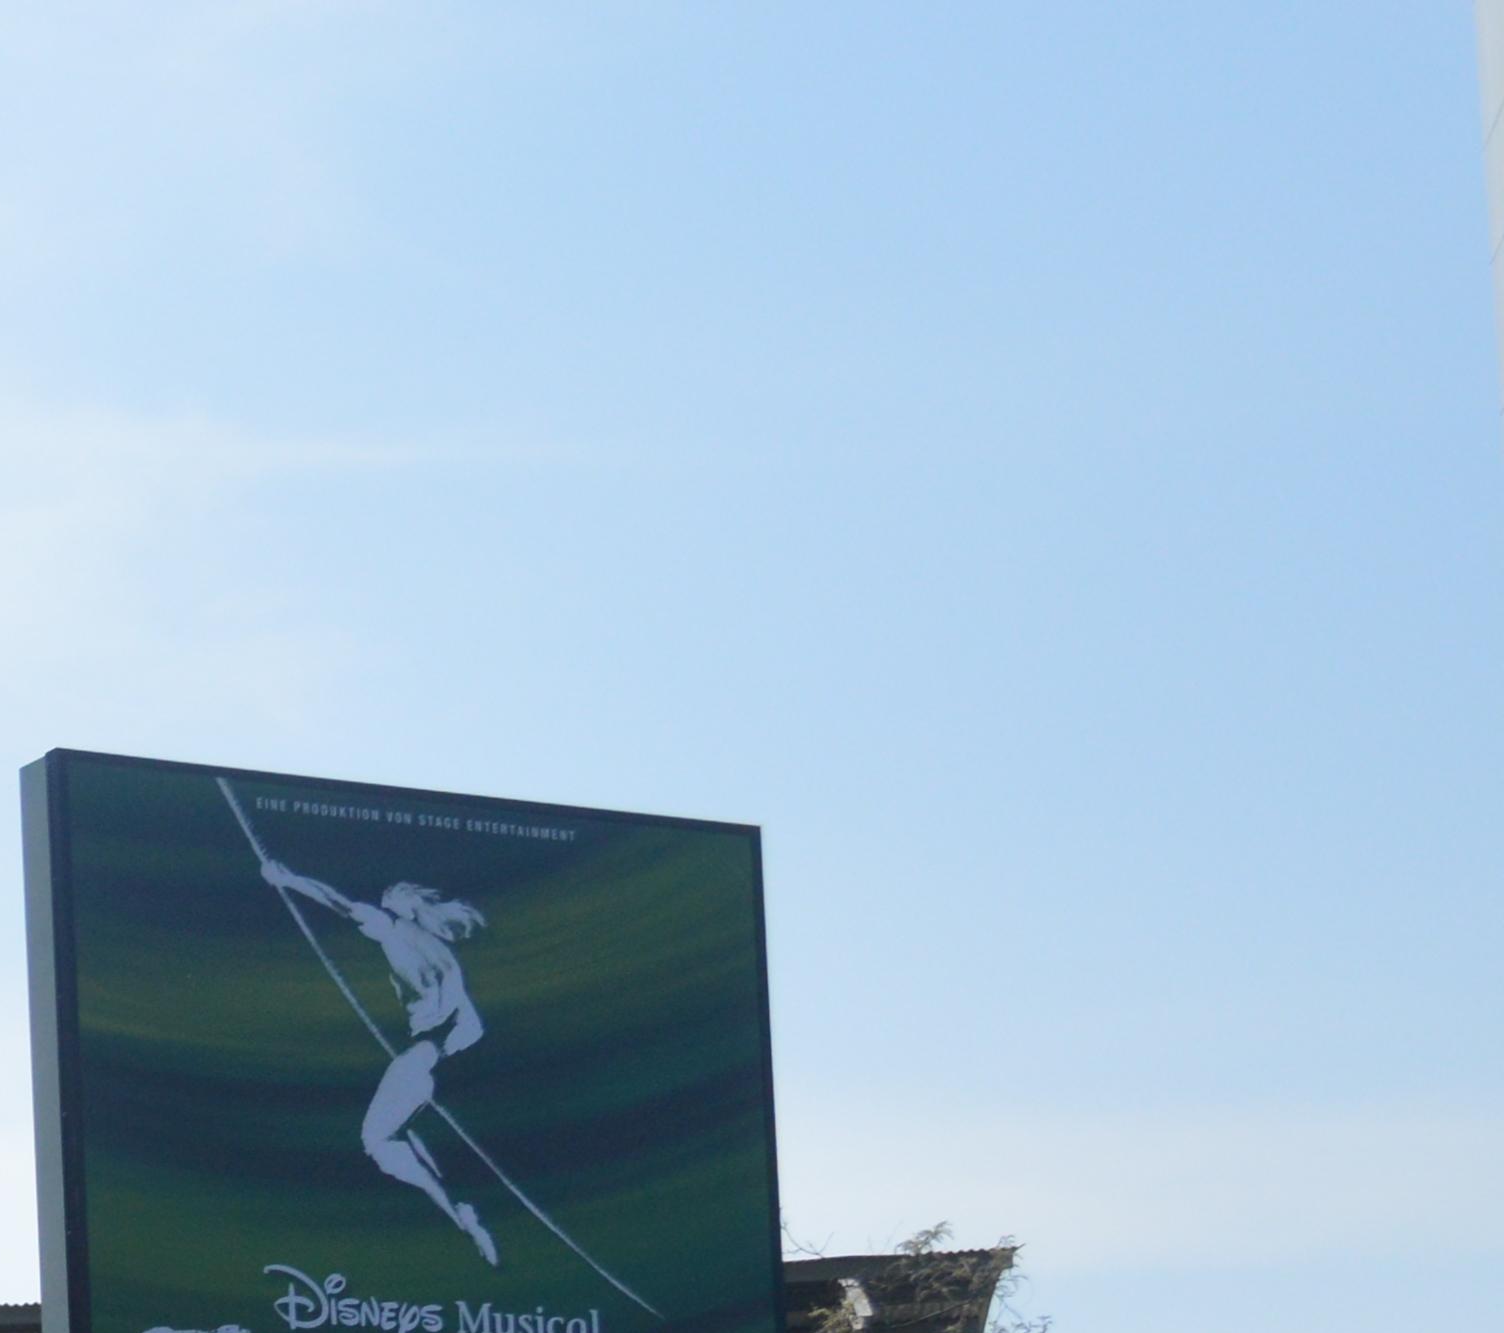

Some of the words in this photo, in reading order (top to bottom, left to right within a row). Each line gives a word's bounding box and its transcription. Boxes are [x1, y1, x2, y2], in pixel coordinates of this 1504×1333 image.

[293, 801, 380, 822] PRODUKTION
[387, 810, 412, 825] VON
[418, 813, 460, 831] STAGE
[467, 819, 576, 842] ENTERTAINMENT
